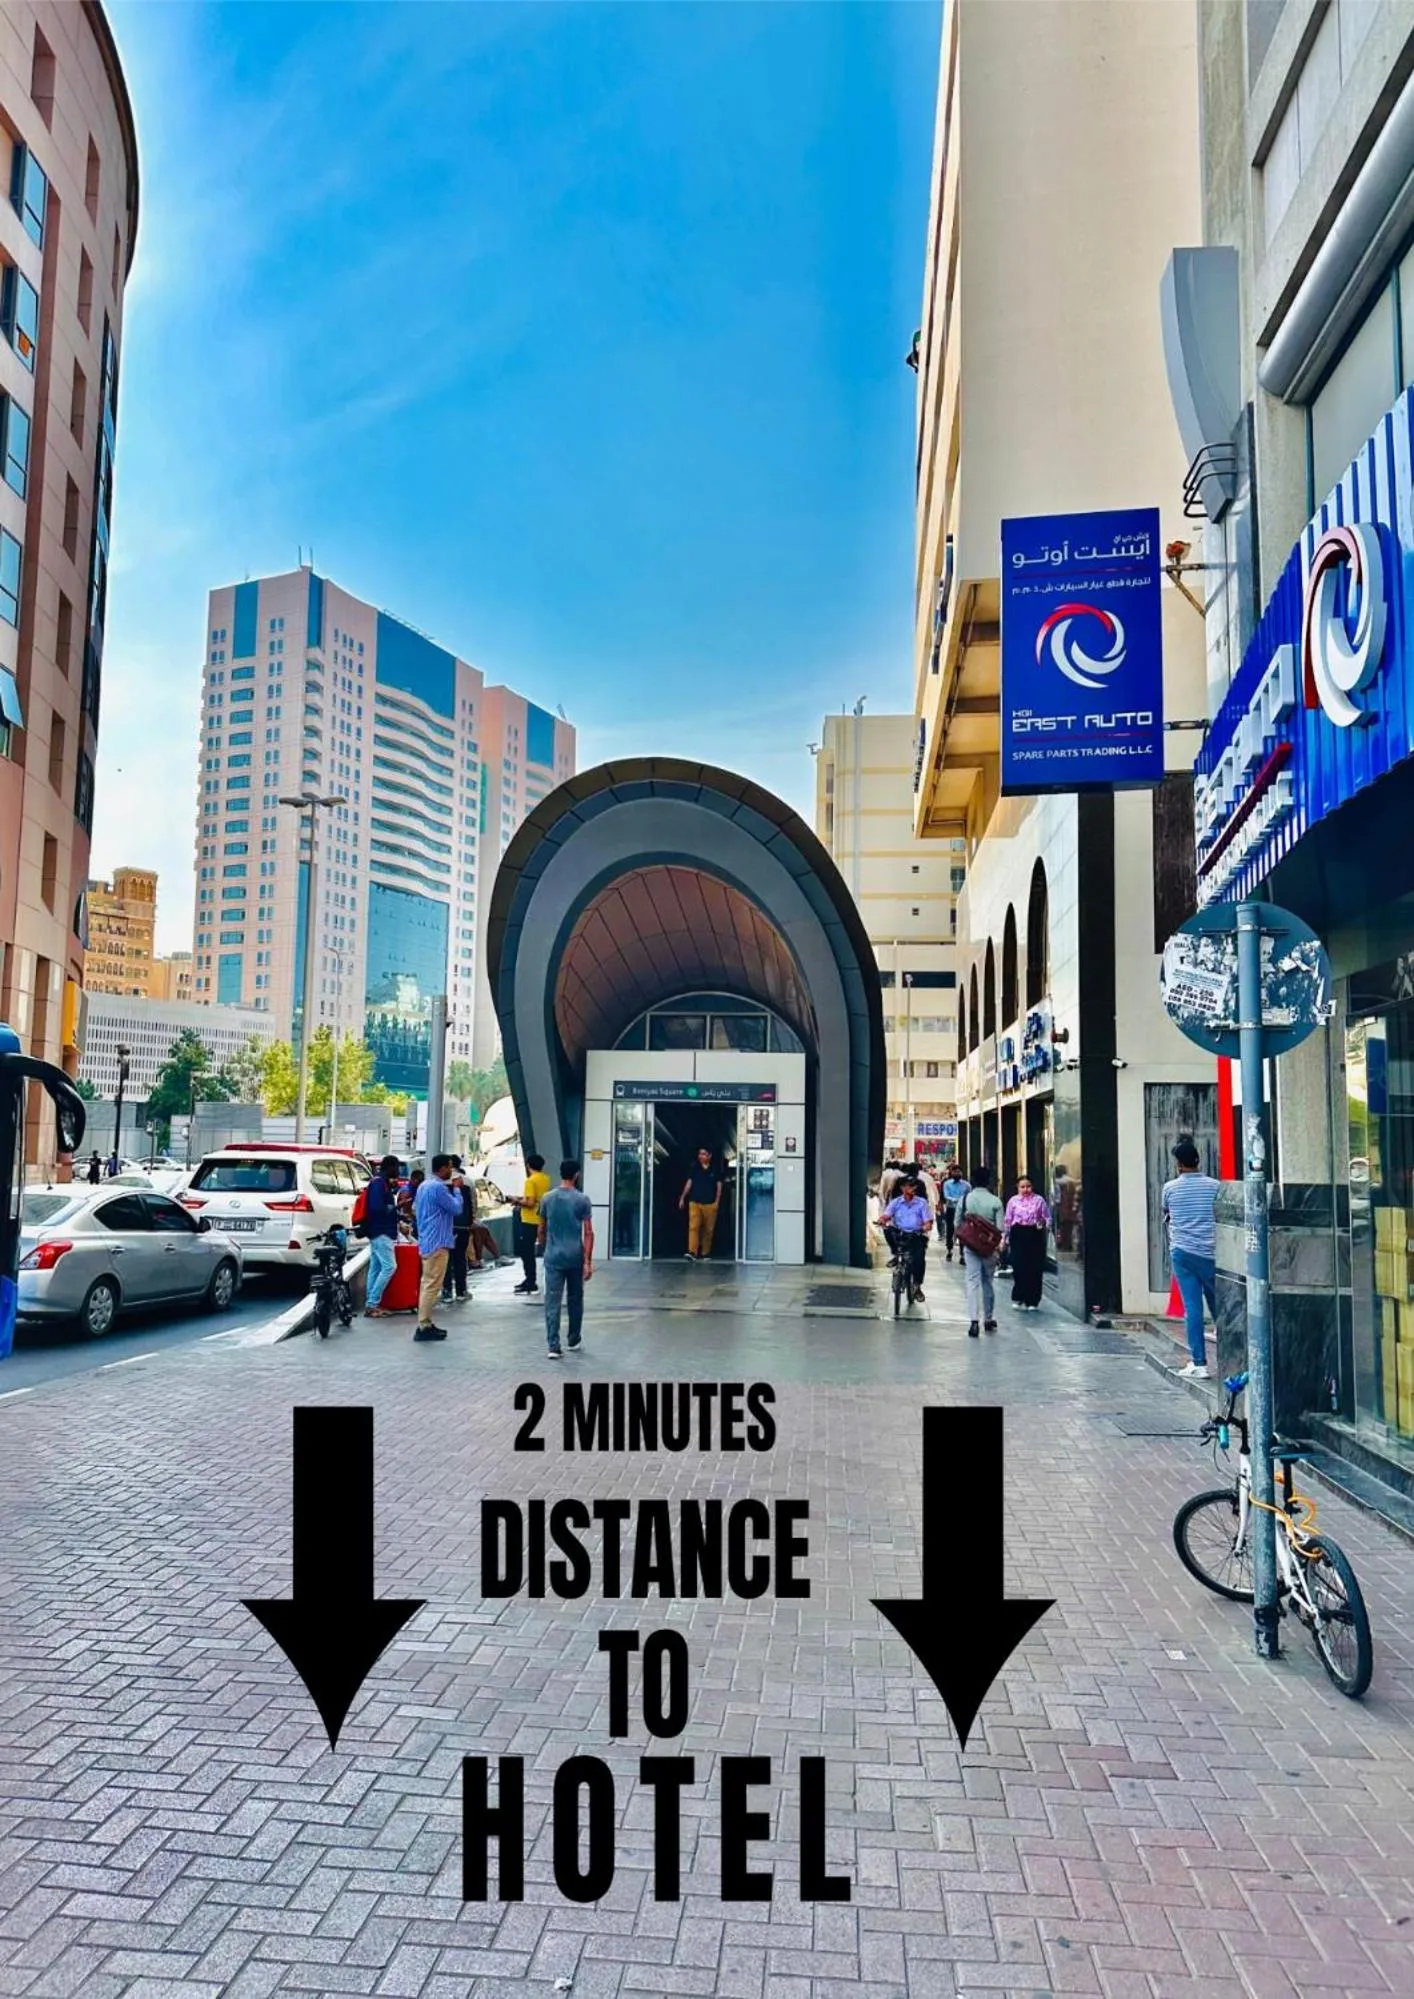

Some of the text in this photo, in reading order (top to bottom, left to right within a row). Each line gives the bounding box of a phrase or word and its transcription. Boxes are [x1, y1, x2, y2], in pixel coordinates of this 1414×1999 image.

[1012, 540, 1069, 569] أوتو
[1012, 711, 1153, 733] EAST AUTO
[1012, 750, 1045, 761] SPARE
[1046, 748, 1079, 759] PARTS
[1079, 745, 1127, 757] TRADING
